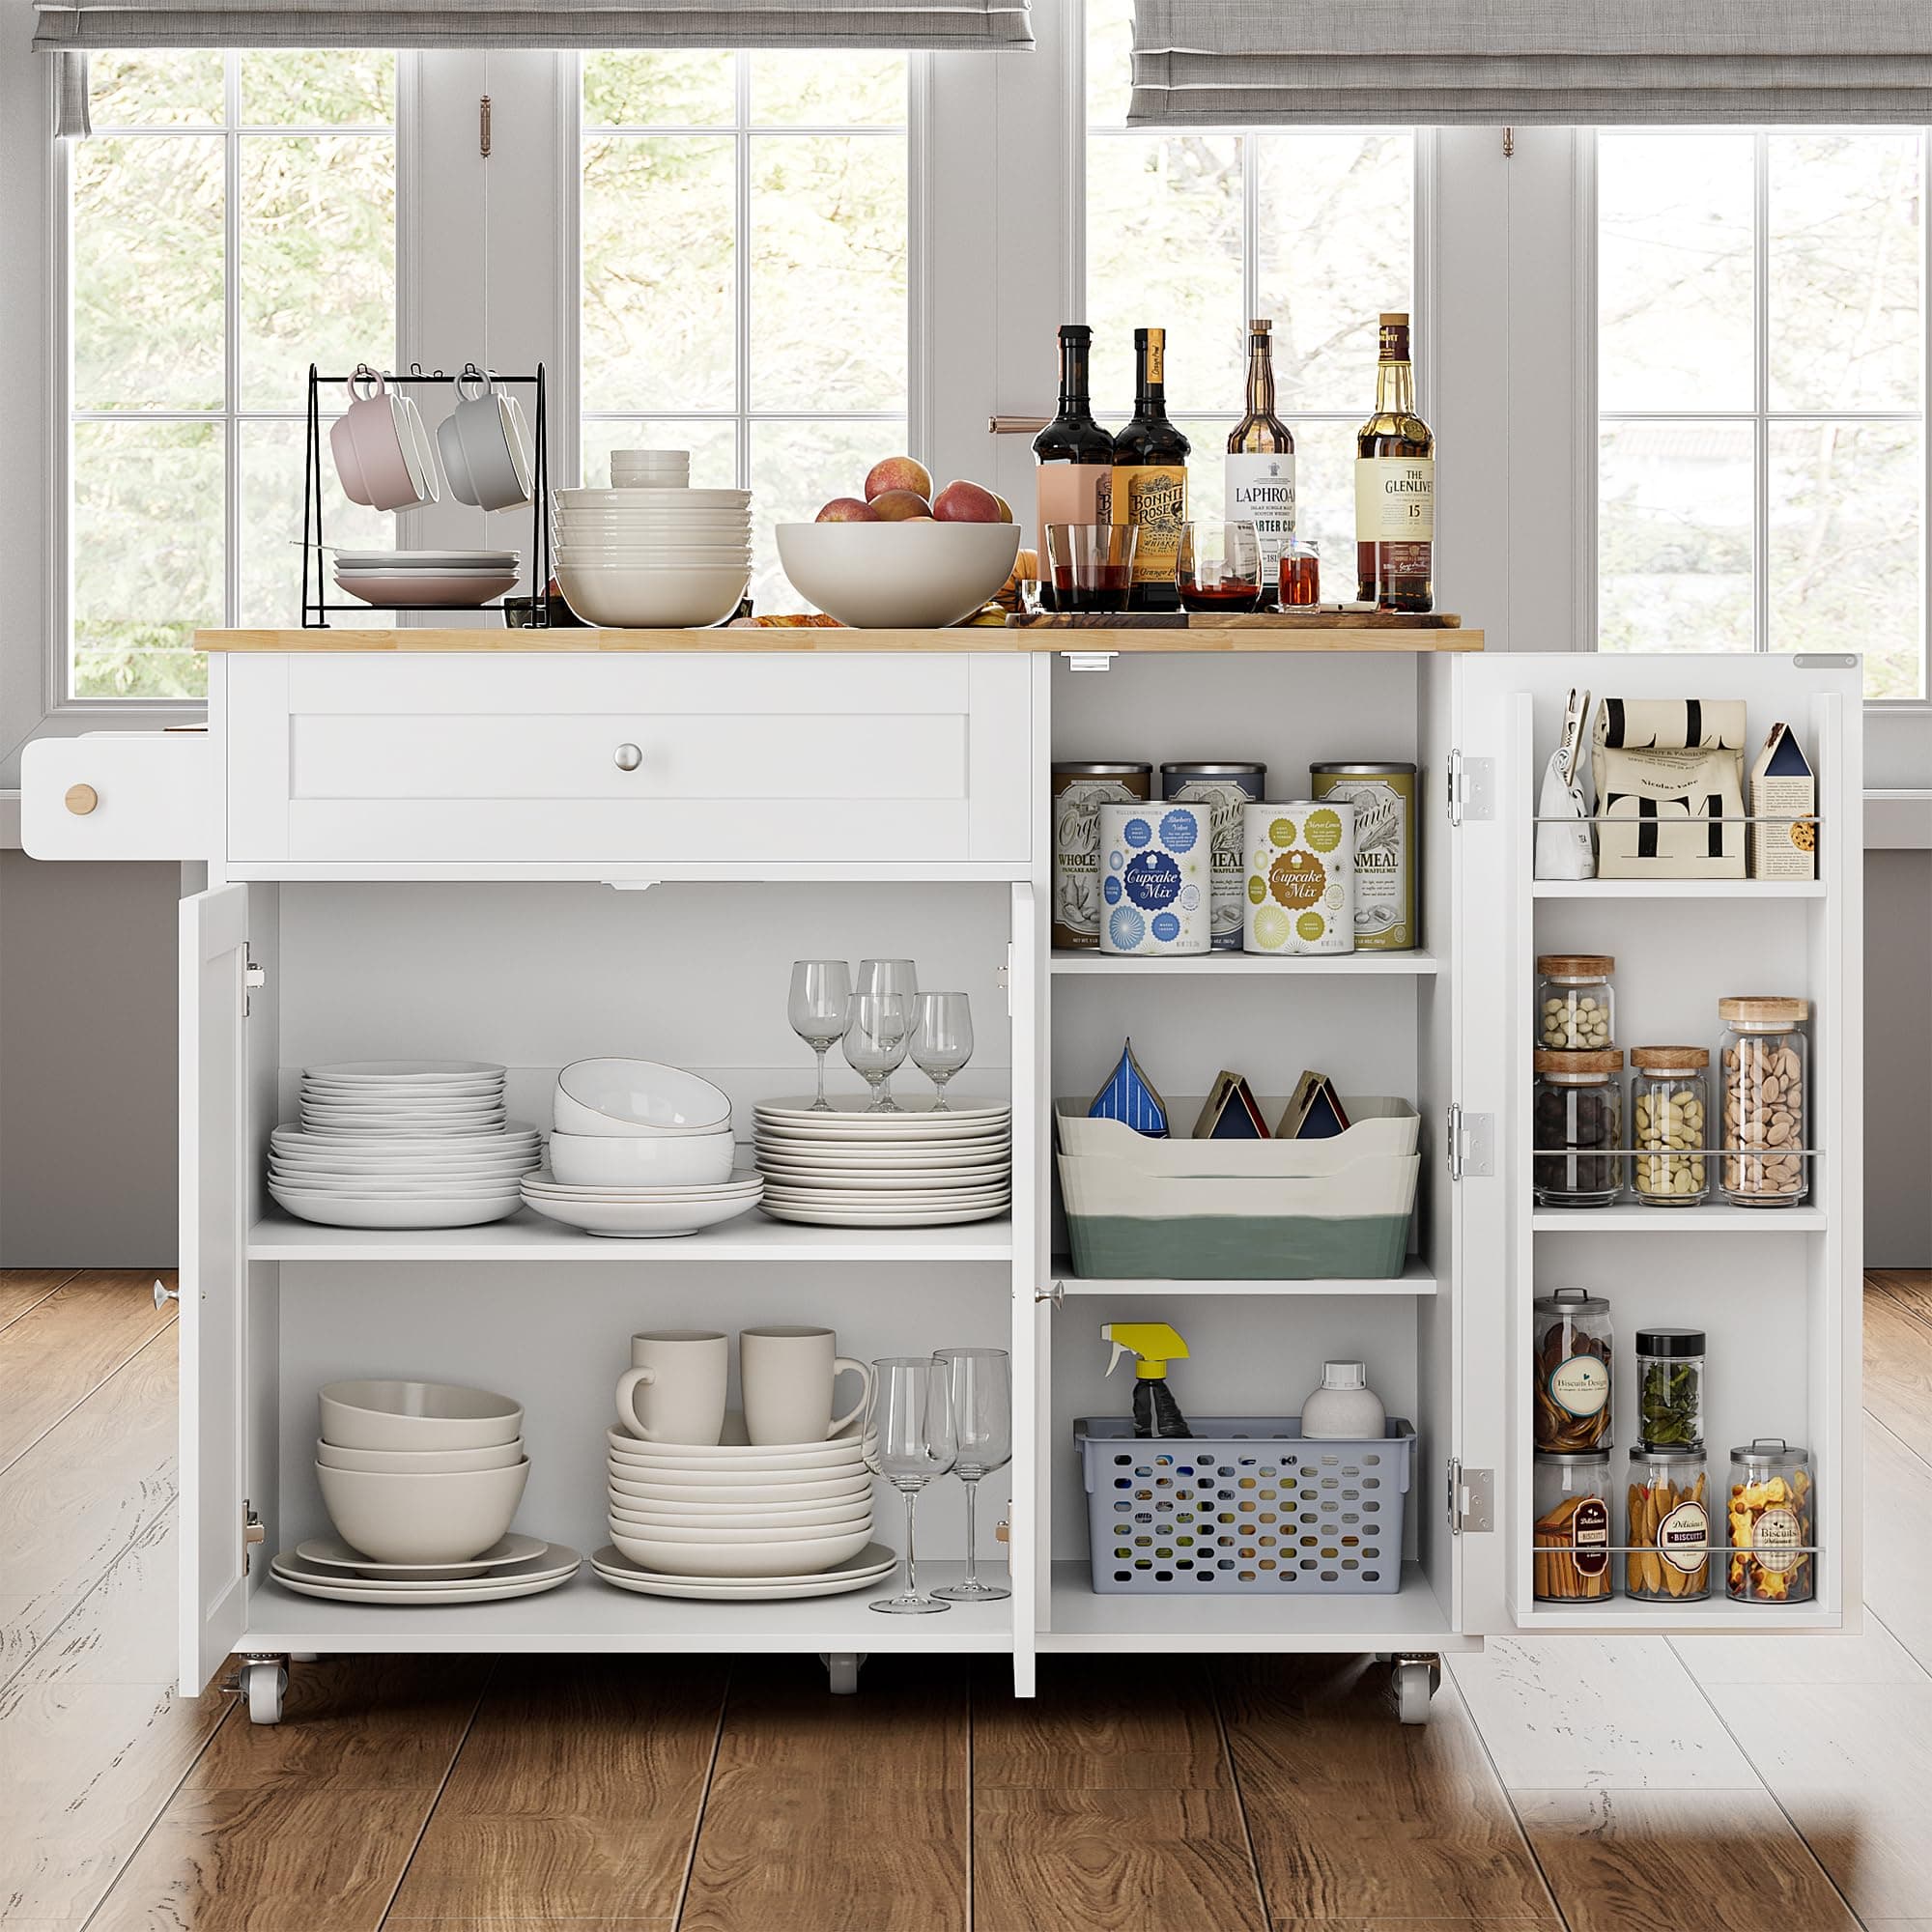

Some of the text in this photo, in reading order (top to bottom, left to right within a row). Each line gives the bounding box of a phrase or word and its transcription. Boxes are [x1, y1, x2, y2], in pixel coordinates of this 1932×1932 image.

[1406, 470, 1423, 479] THE
[1385, 480, 1434, 494] GLENLIVE
[1139, 503, 1170, 525] ROSE
[1408, 504, 1421, 518] 15
[1059, 854, 1096, 867] WHOLE
[1126, 868, 1178, 887] Cupcake
[1272, 867, 1322, 886] Cupcake
[1140, 884, 1173, 899] Mix
[1285, 883, 1318, 898] Mix
[1674, 1532, 1703, 1542] BISCUITS
[1761, 1527, 1797, 1538] Biscuits
